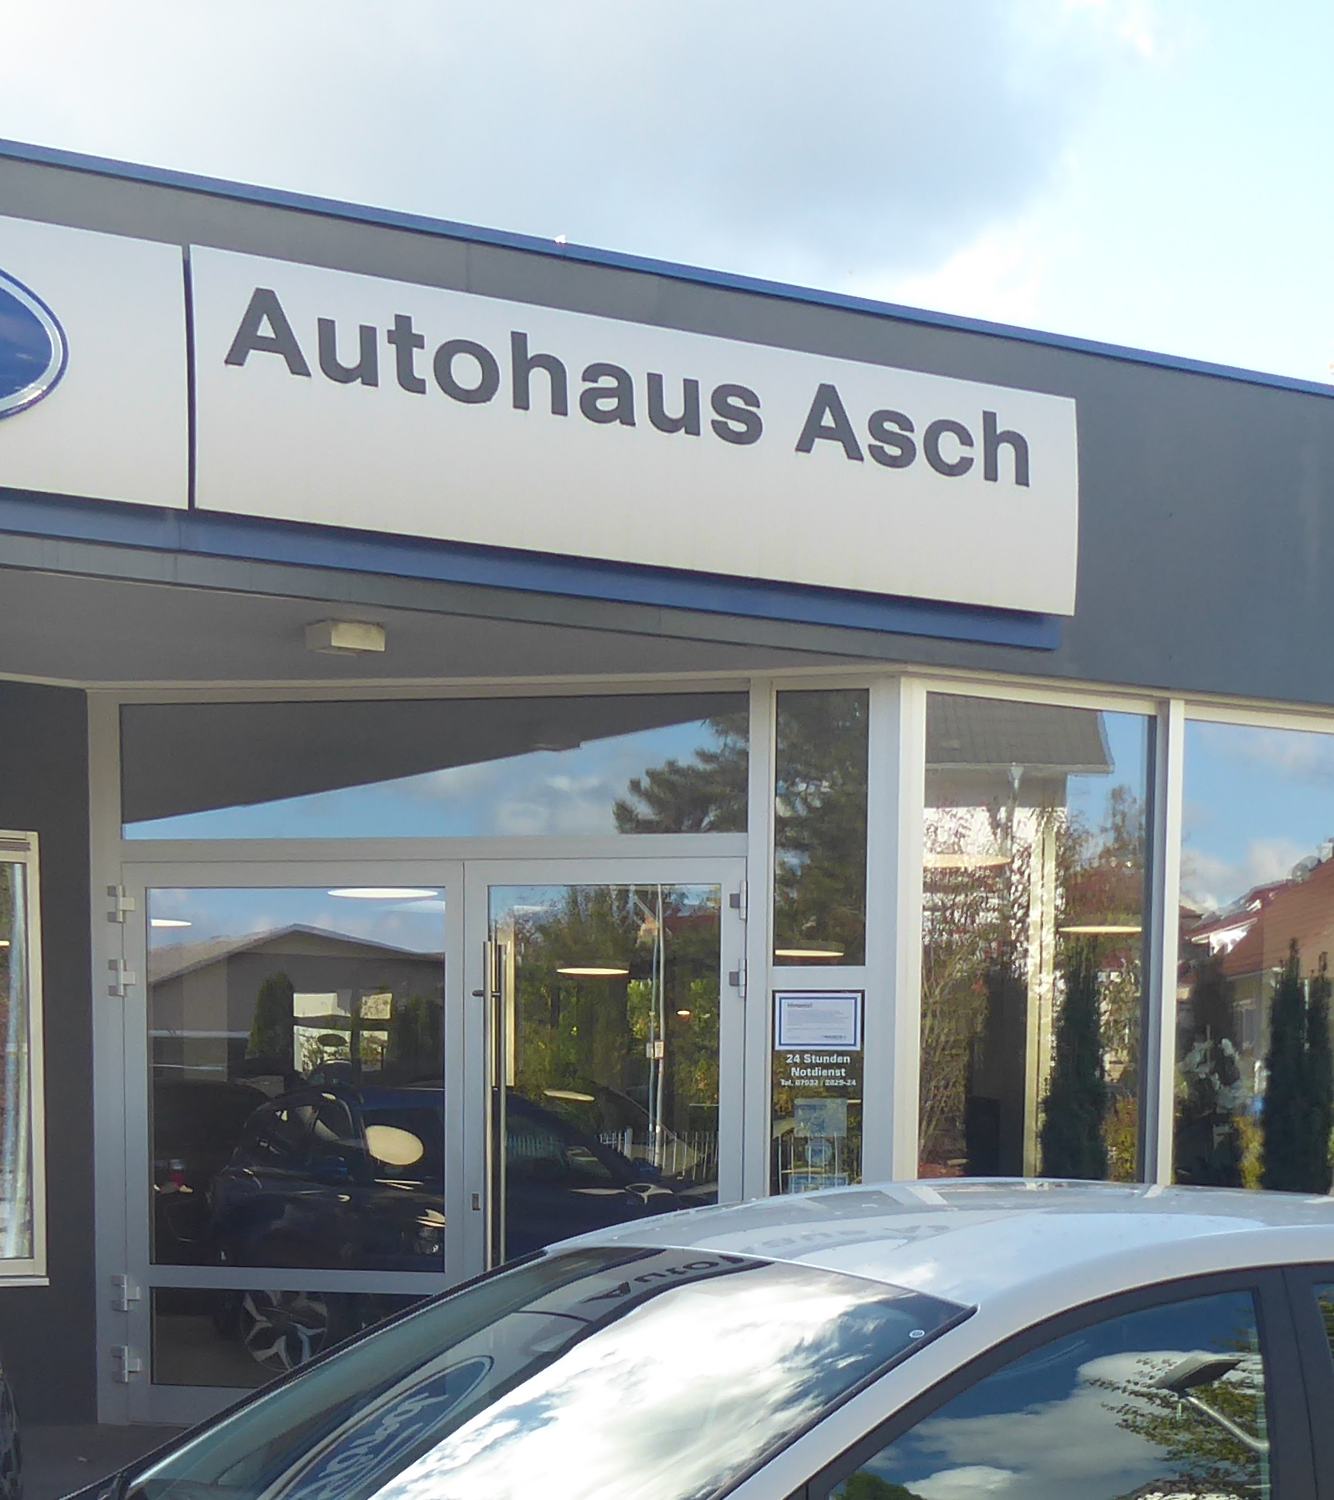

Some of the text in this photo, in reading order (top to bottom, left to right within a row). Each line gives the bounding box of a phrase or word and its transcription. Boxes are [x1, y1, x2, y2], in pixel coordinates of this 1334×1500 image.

[224, 287, 1031, 489] Autohaus Asch
[786, 1053, 851, 1064] 24 Stunden
[791, 1067, 846, 1077] Notdienst
